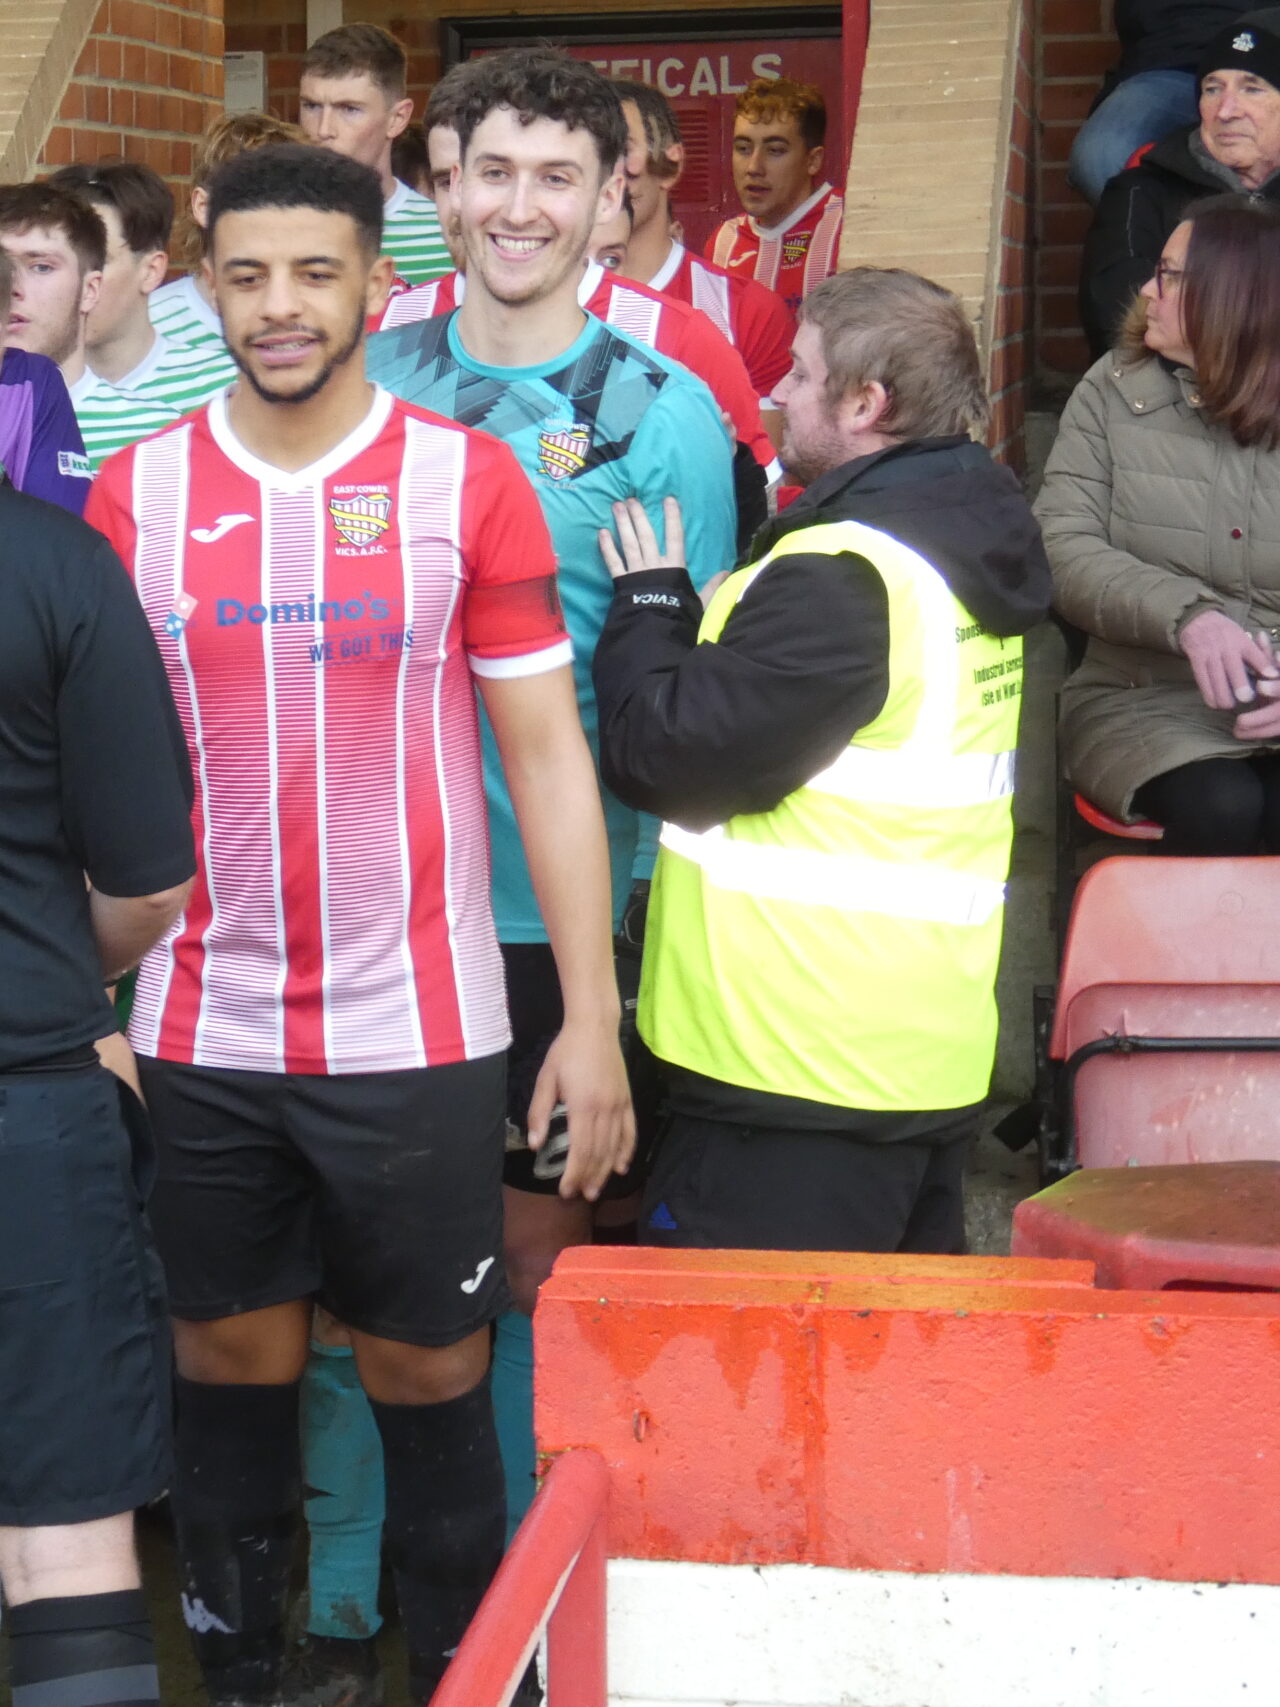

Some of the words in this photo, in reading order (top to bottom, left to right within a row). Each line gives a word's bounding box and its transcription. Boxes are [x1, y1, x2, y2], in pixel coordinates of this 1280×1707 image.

[590, 53, 783, 97] FICALS
[333, 485, 355, 494] EAST
[356, 485, 389, 494] COWES
[216, 590, 391, 627] Domino's
[309, 641, 334, 663] WE
[340, 635, 372, 658] GOT
[379, 629, 414, 652] THIS
